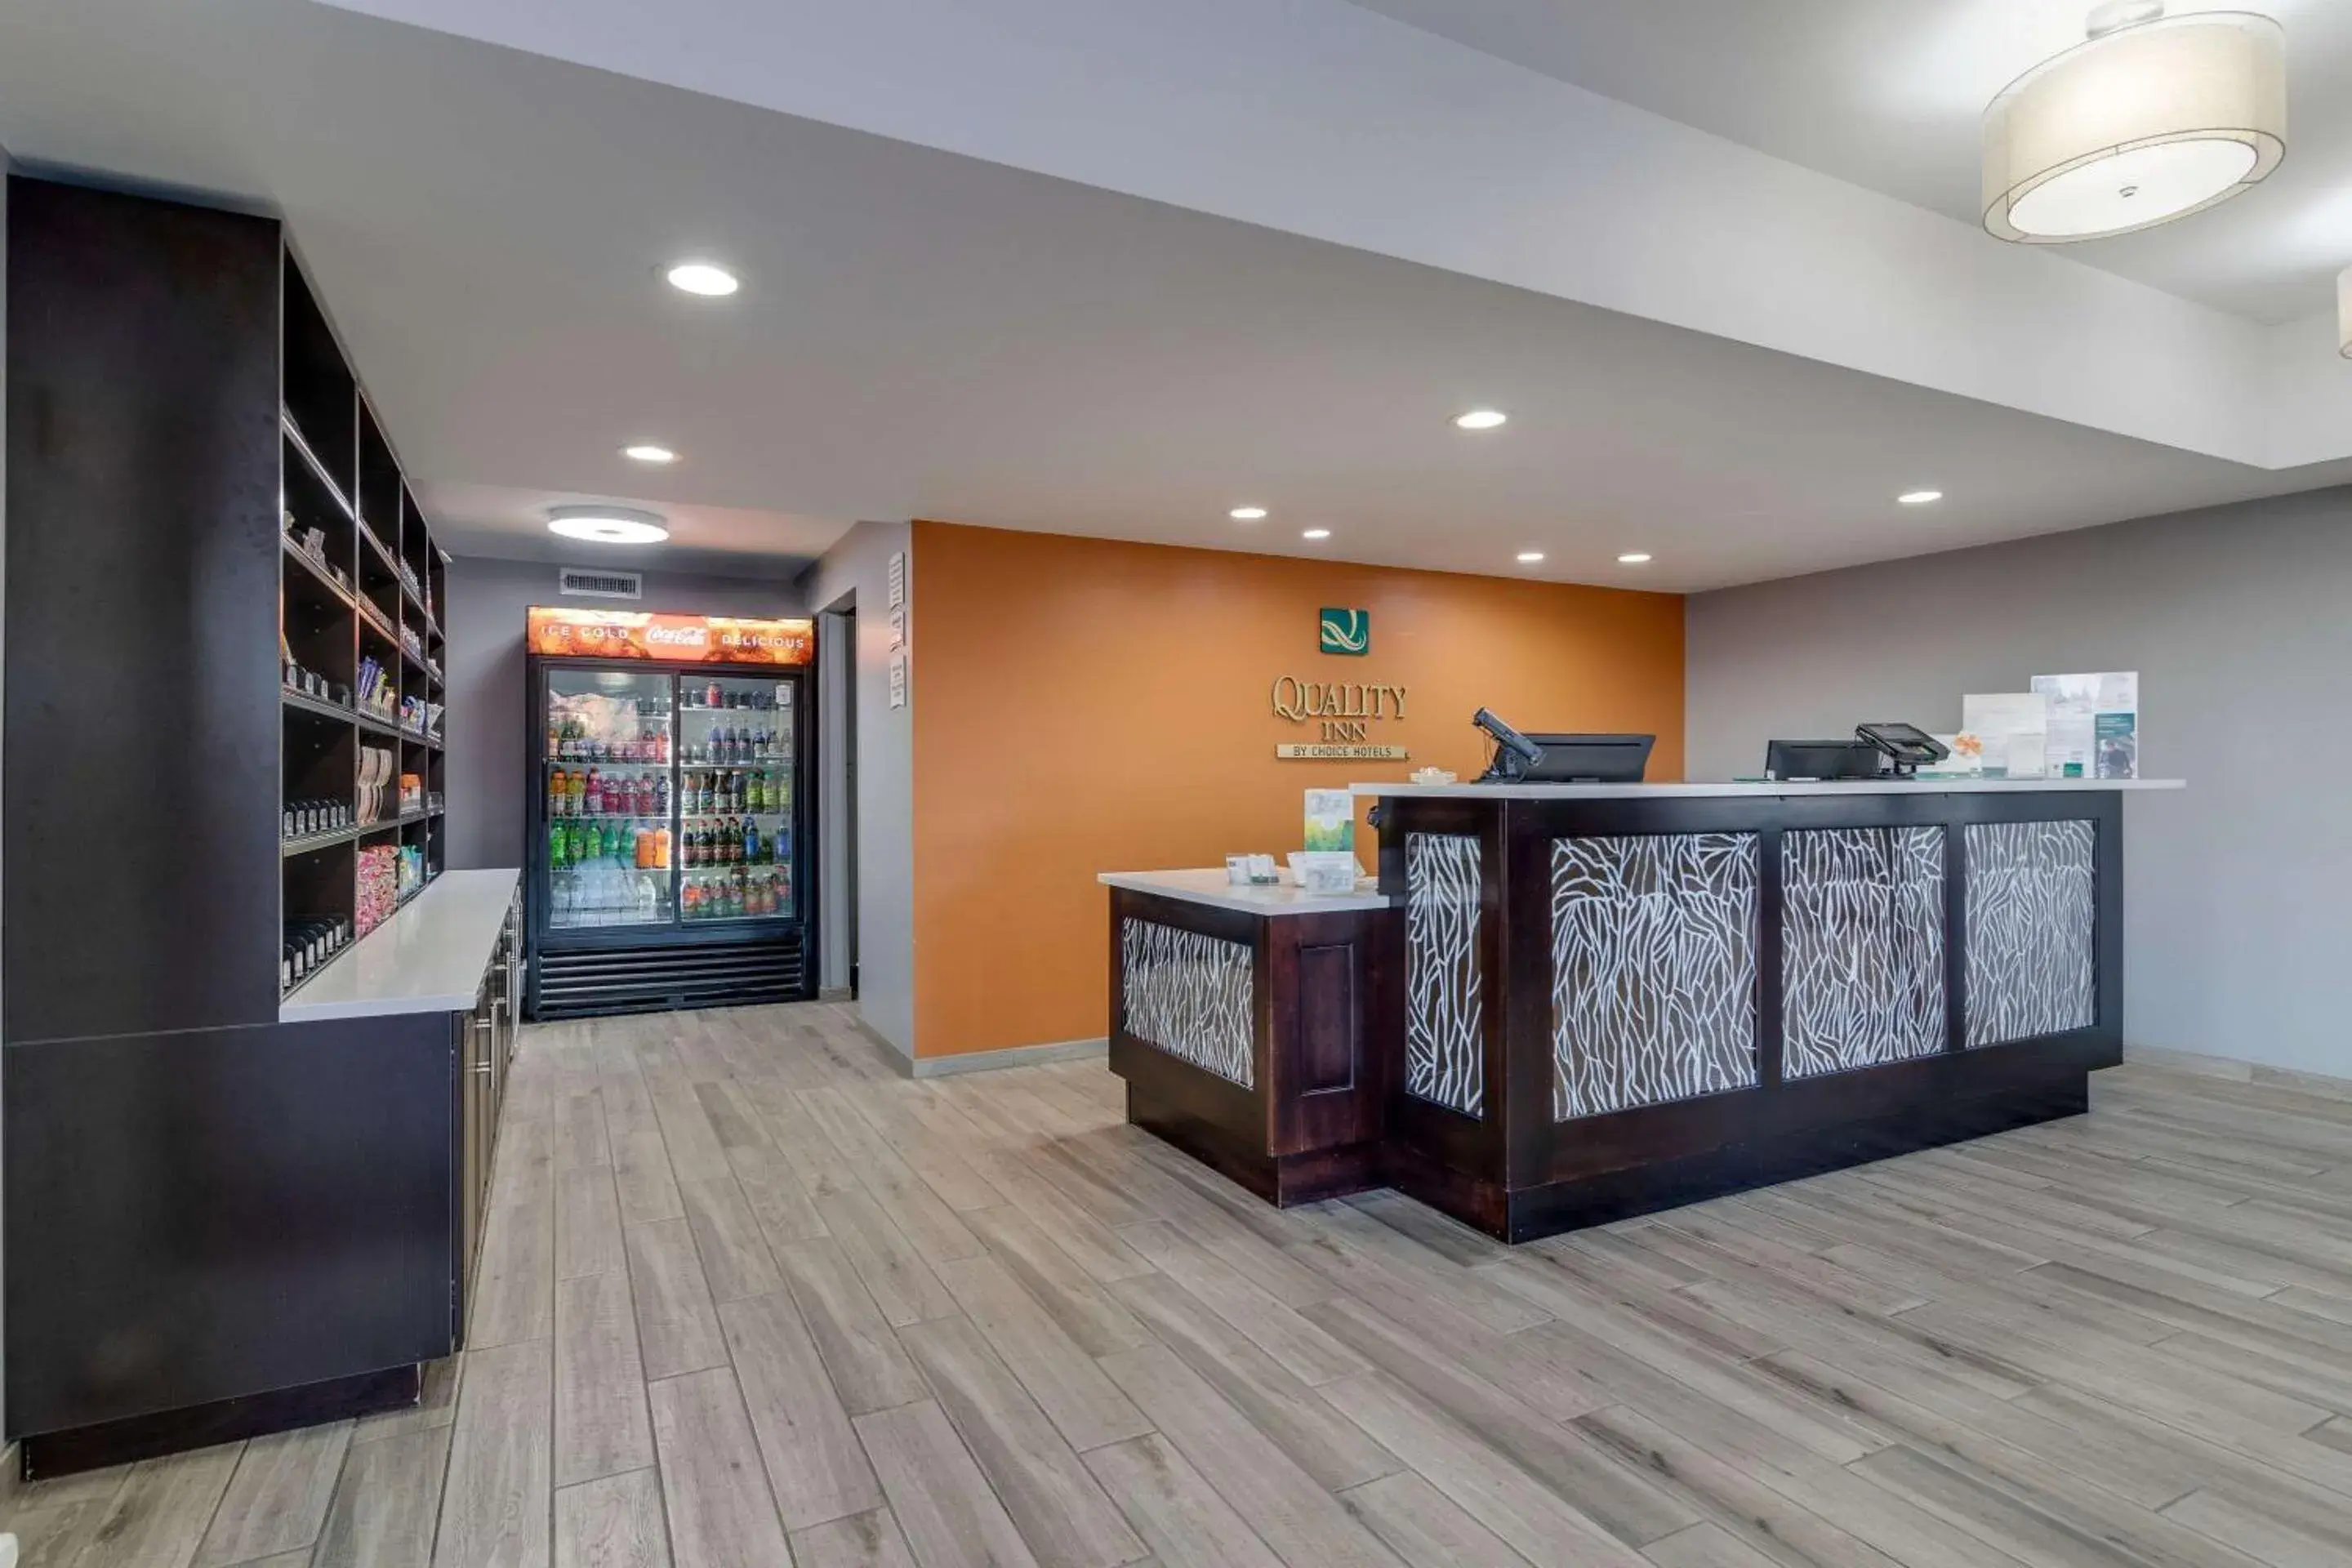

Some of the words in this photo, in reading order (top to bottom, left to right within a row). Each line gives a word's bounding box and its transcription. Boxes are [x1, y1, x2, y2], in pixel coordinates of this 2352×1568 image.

[541, 626, 570, 637] ICE
[580, 627, 629, 639] COLD
[722, 634, 804, 649] DELICIOUS
[1273, 675, 1406, 721] QUALITY
[1321, 720, 1366, 742] INN
[1294, 746, 1307, 756] BY
[1312, 746, 1349, 756] CHOICE
[1353, 746, 1392, 757] HOTELS
